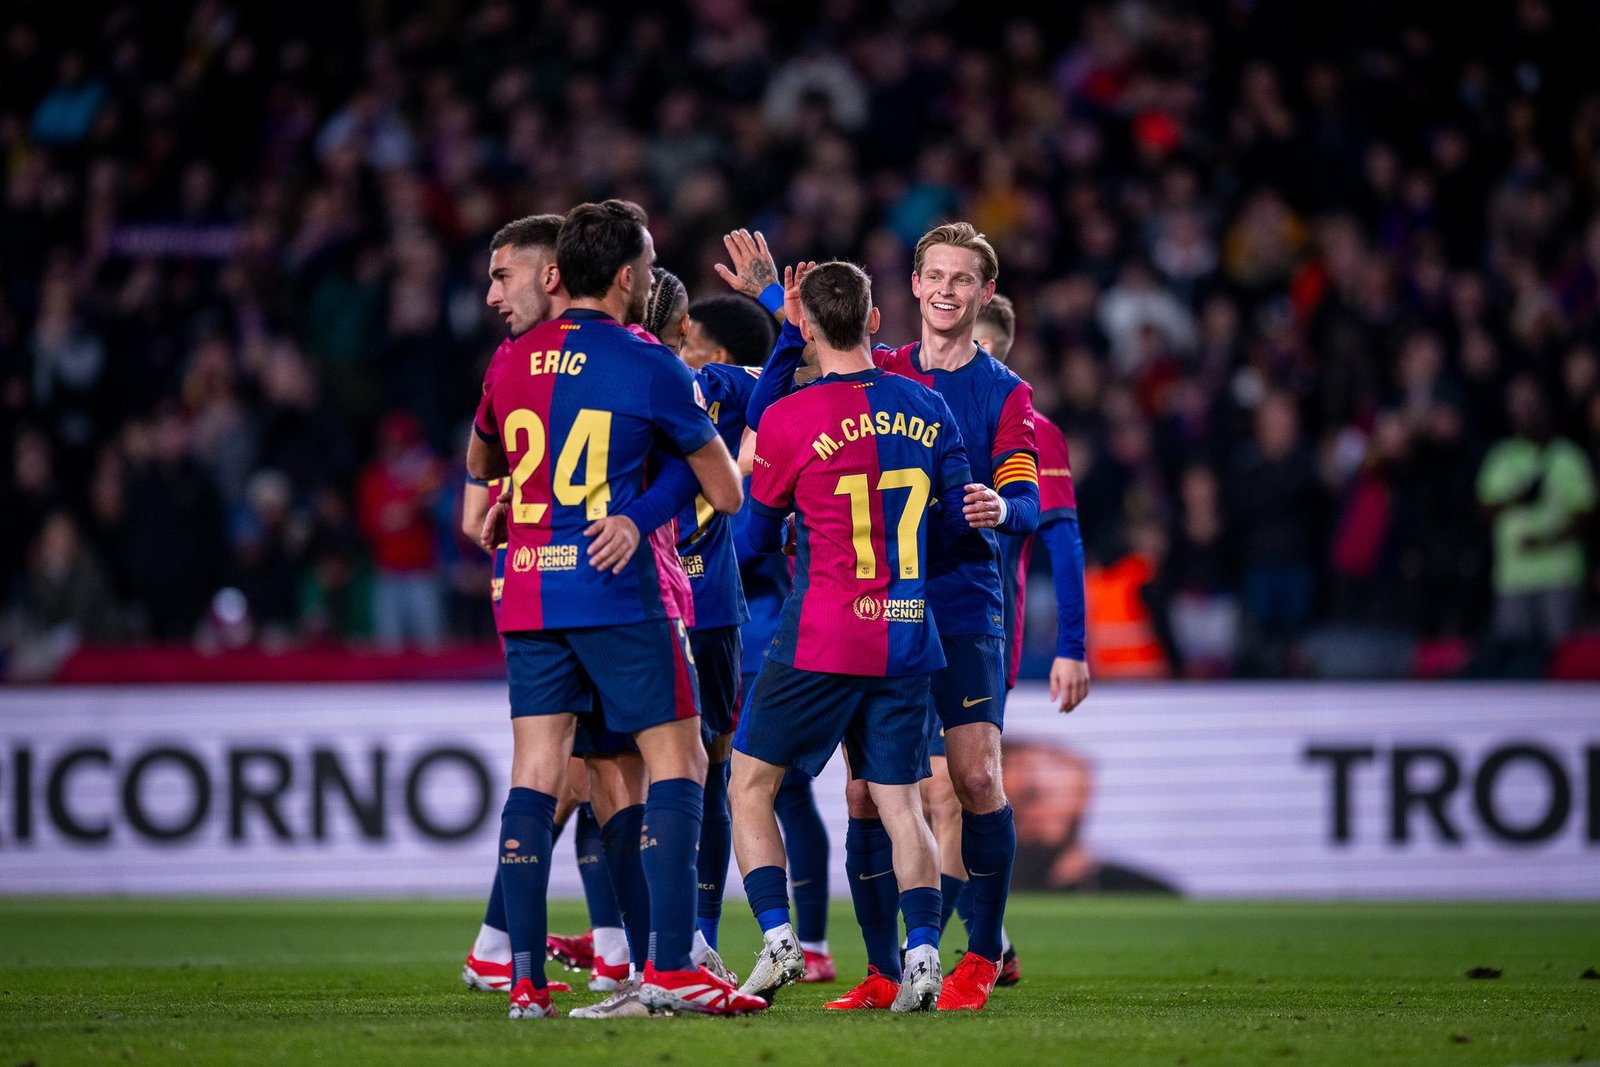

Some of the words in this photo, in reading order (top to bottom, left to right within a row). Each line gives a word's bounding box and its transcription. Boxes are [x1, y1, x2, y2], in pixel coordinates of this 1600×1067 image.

[530, 350, 587, 376] ERIC
[504, 409, 612, 524] 24
[834, 467, 931, 579] 17
[537, 545, 578, 556] UNHCR
[537, 556, 577, 566] ACNUR
[883, 599, 925, 609] UNHCR
[883, 608, 924, 619] ACNUR
[0, 741, 497, 846] ICORNO
